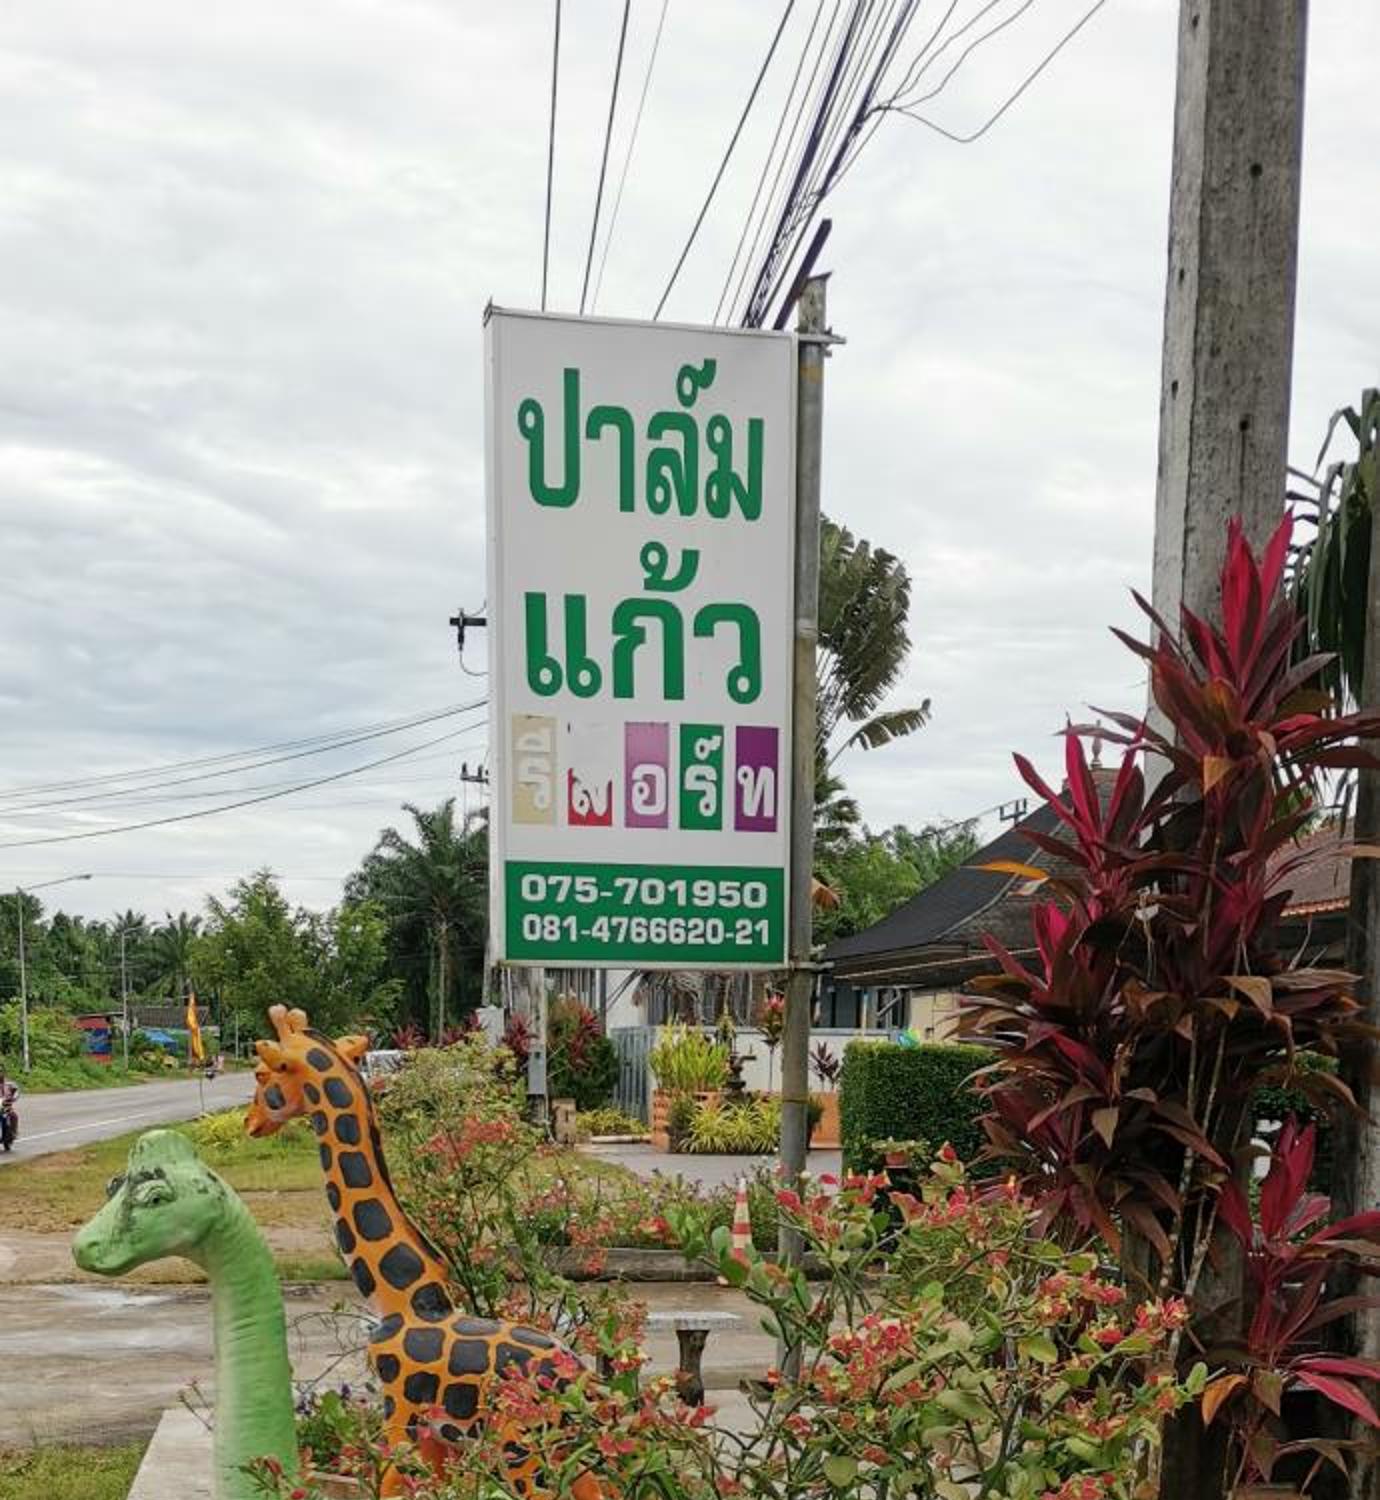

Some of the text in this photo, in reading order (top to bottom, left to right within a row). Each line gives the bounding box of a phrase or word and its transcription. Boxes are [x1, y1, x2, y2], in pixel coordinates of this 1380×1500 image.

[517, 359, 764, 521] ปาล์ม
[524, 541, 763, 706] แก้ว
[521, 873, 768, 908] 075-701950
[522, 913, 769, 946] 081-4766620-21
